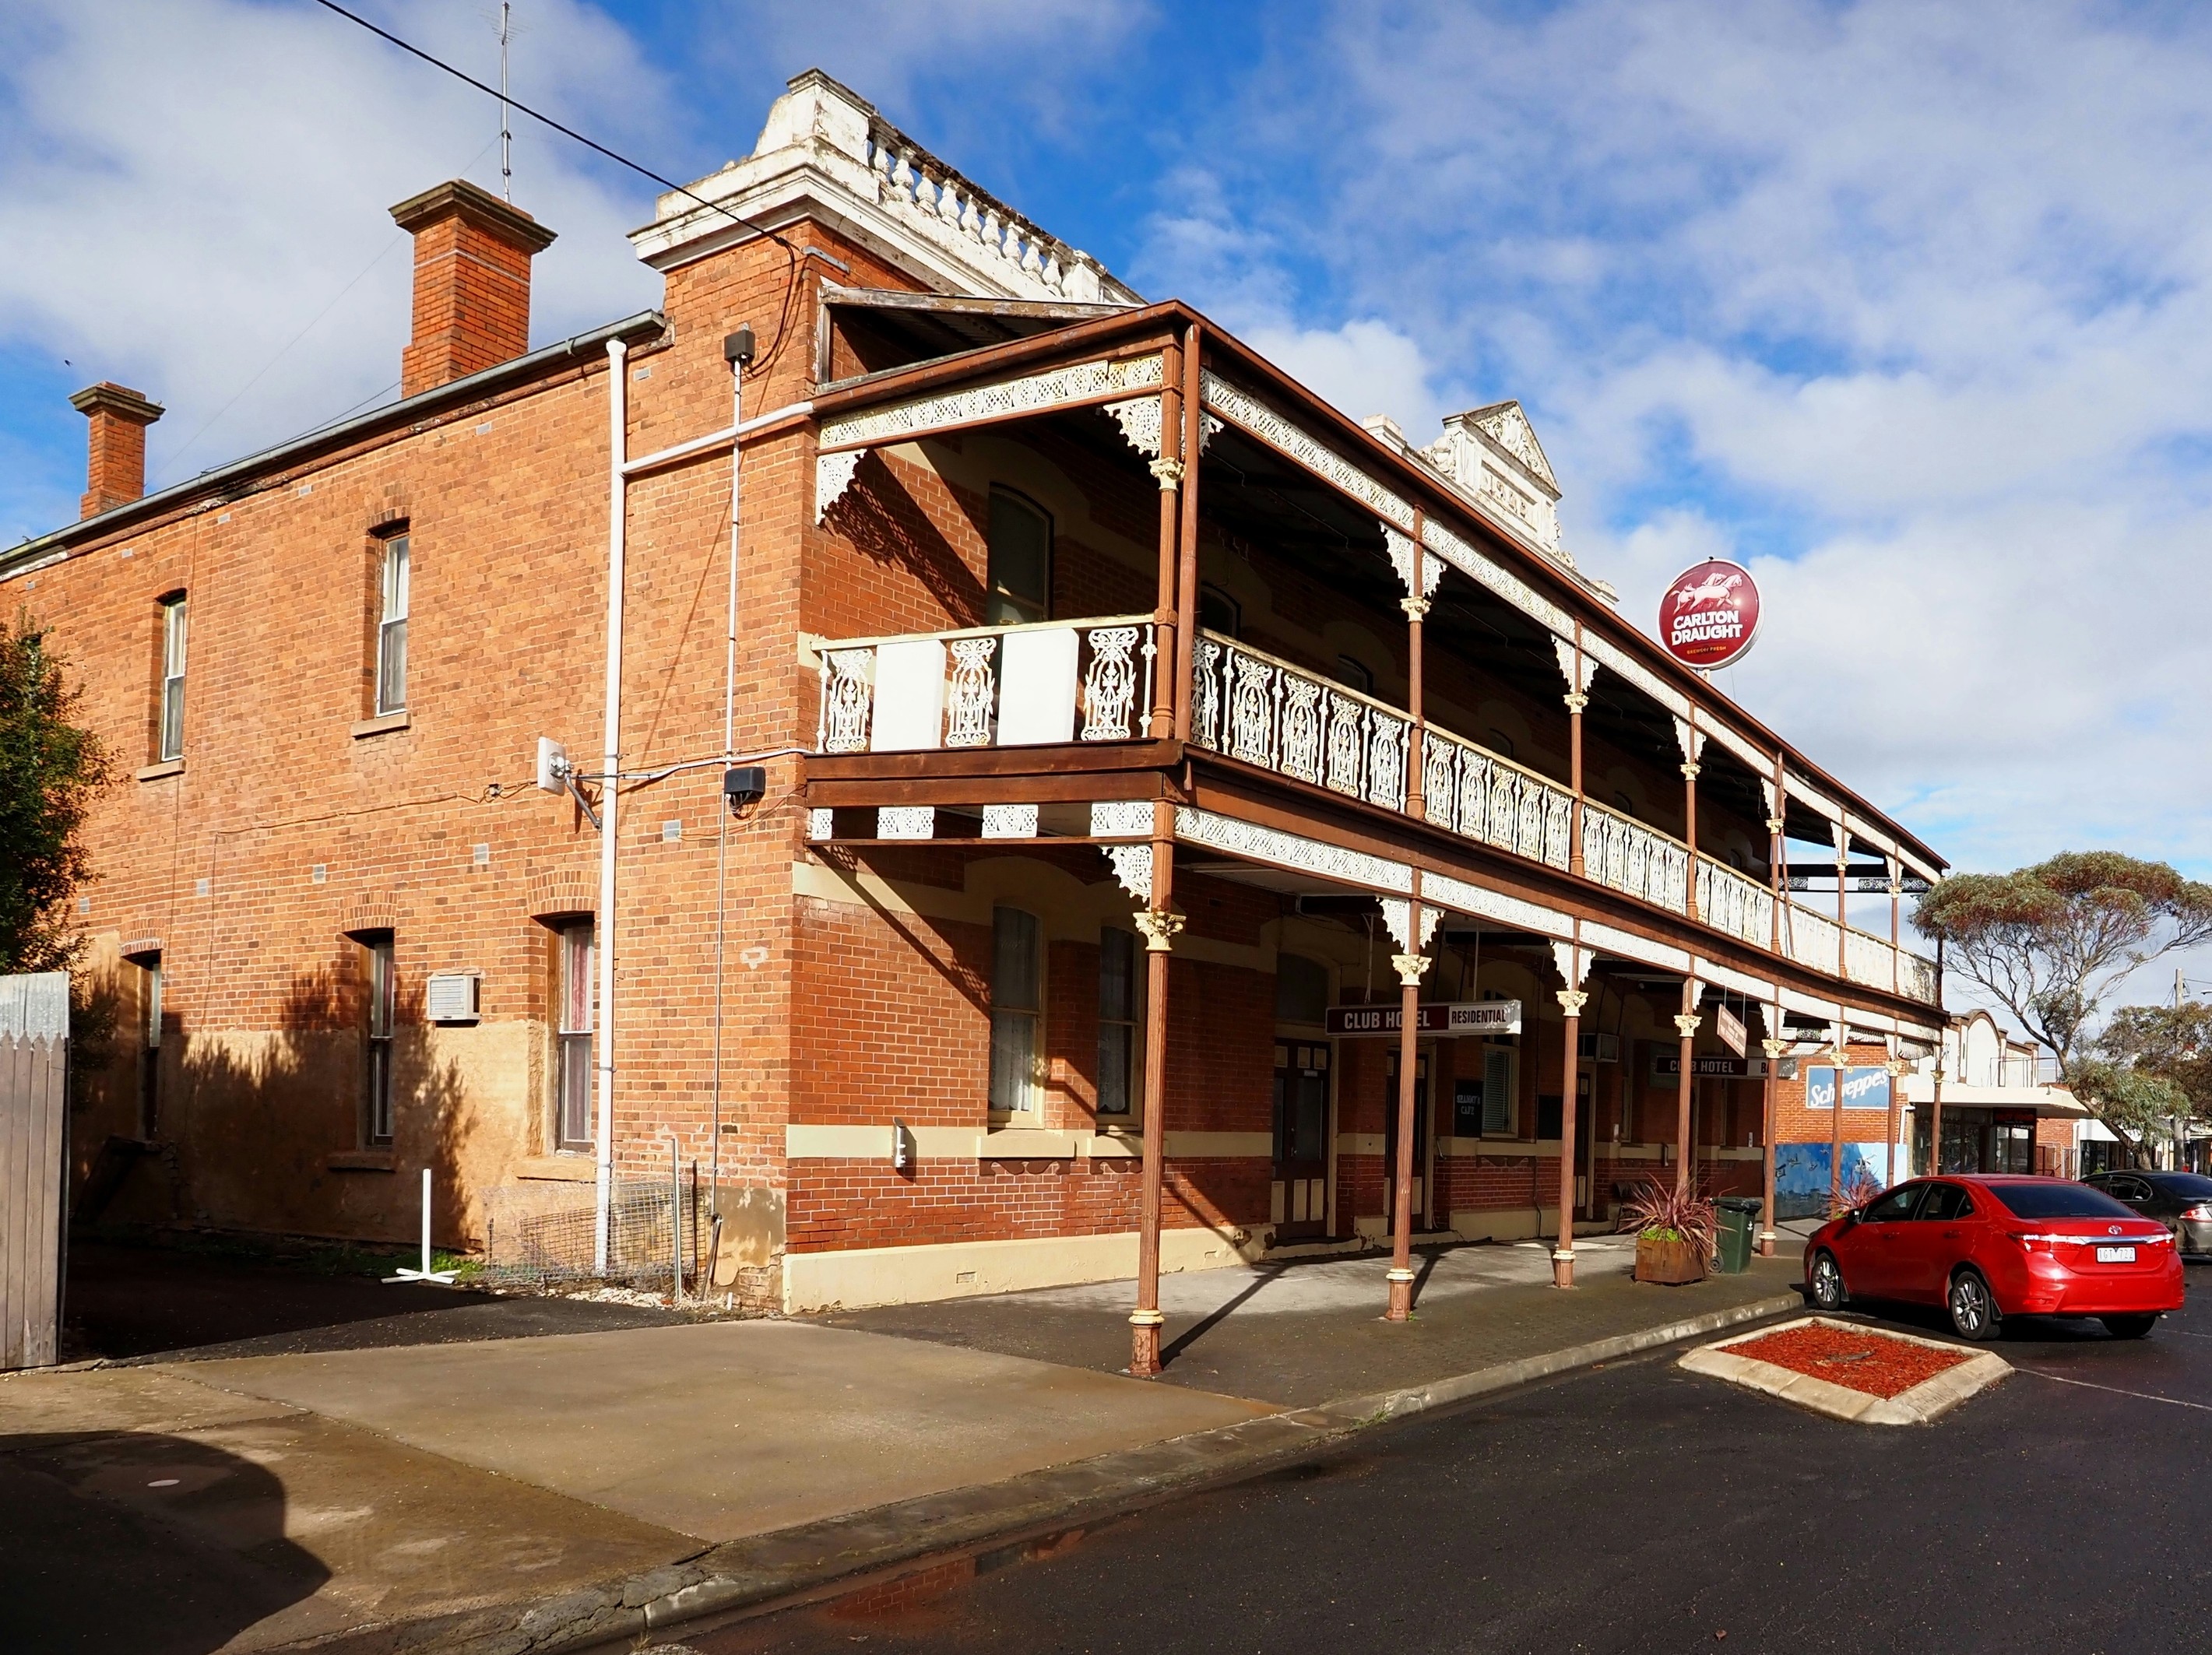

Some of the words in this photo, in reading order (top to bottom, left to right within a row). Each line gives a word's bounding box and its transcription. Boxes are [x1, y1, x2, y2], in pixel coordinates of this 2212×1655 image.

[1673, 610, 1739, 631] CARLTON
[1671, 624, 1743, 646] DRAUGHT
[1345, 1012, 1380, 1028] CLUB
[1386, 1010, 1430, 1028] HOEL
[1451, 1008, 1507, 1024] RESIDENTIAL
[1670, 1060, 1697, 1072] CLB
[1700, 1061, 1734, 1073] HOTEL
